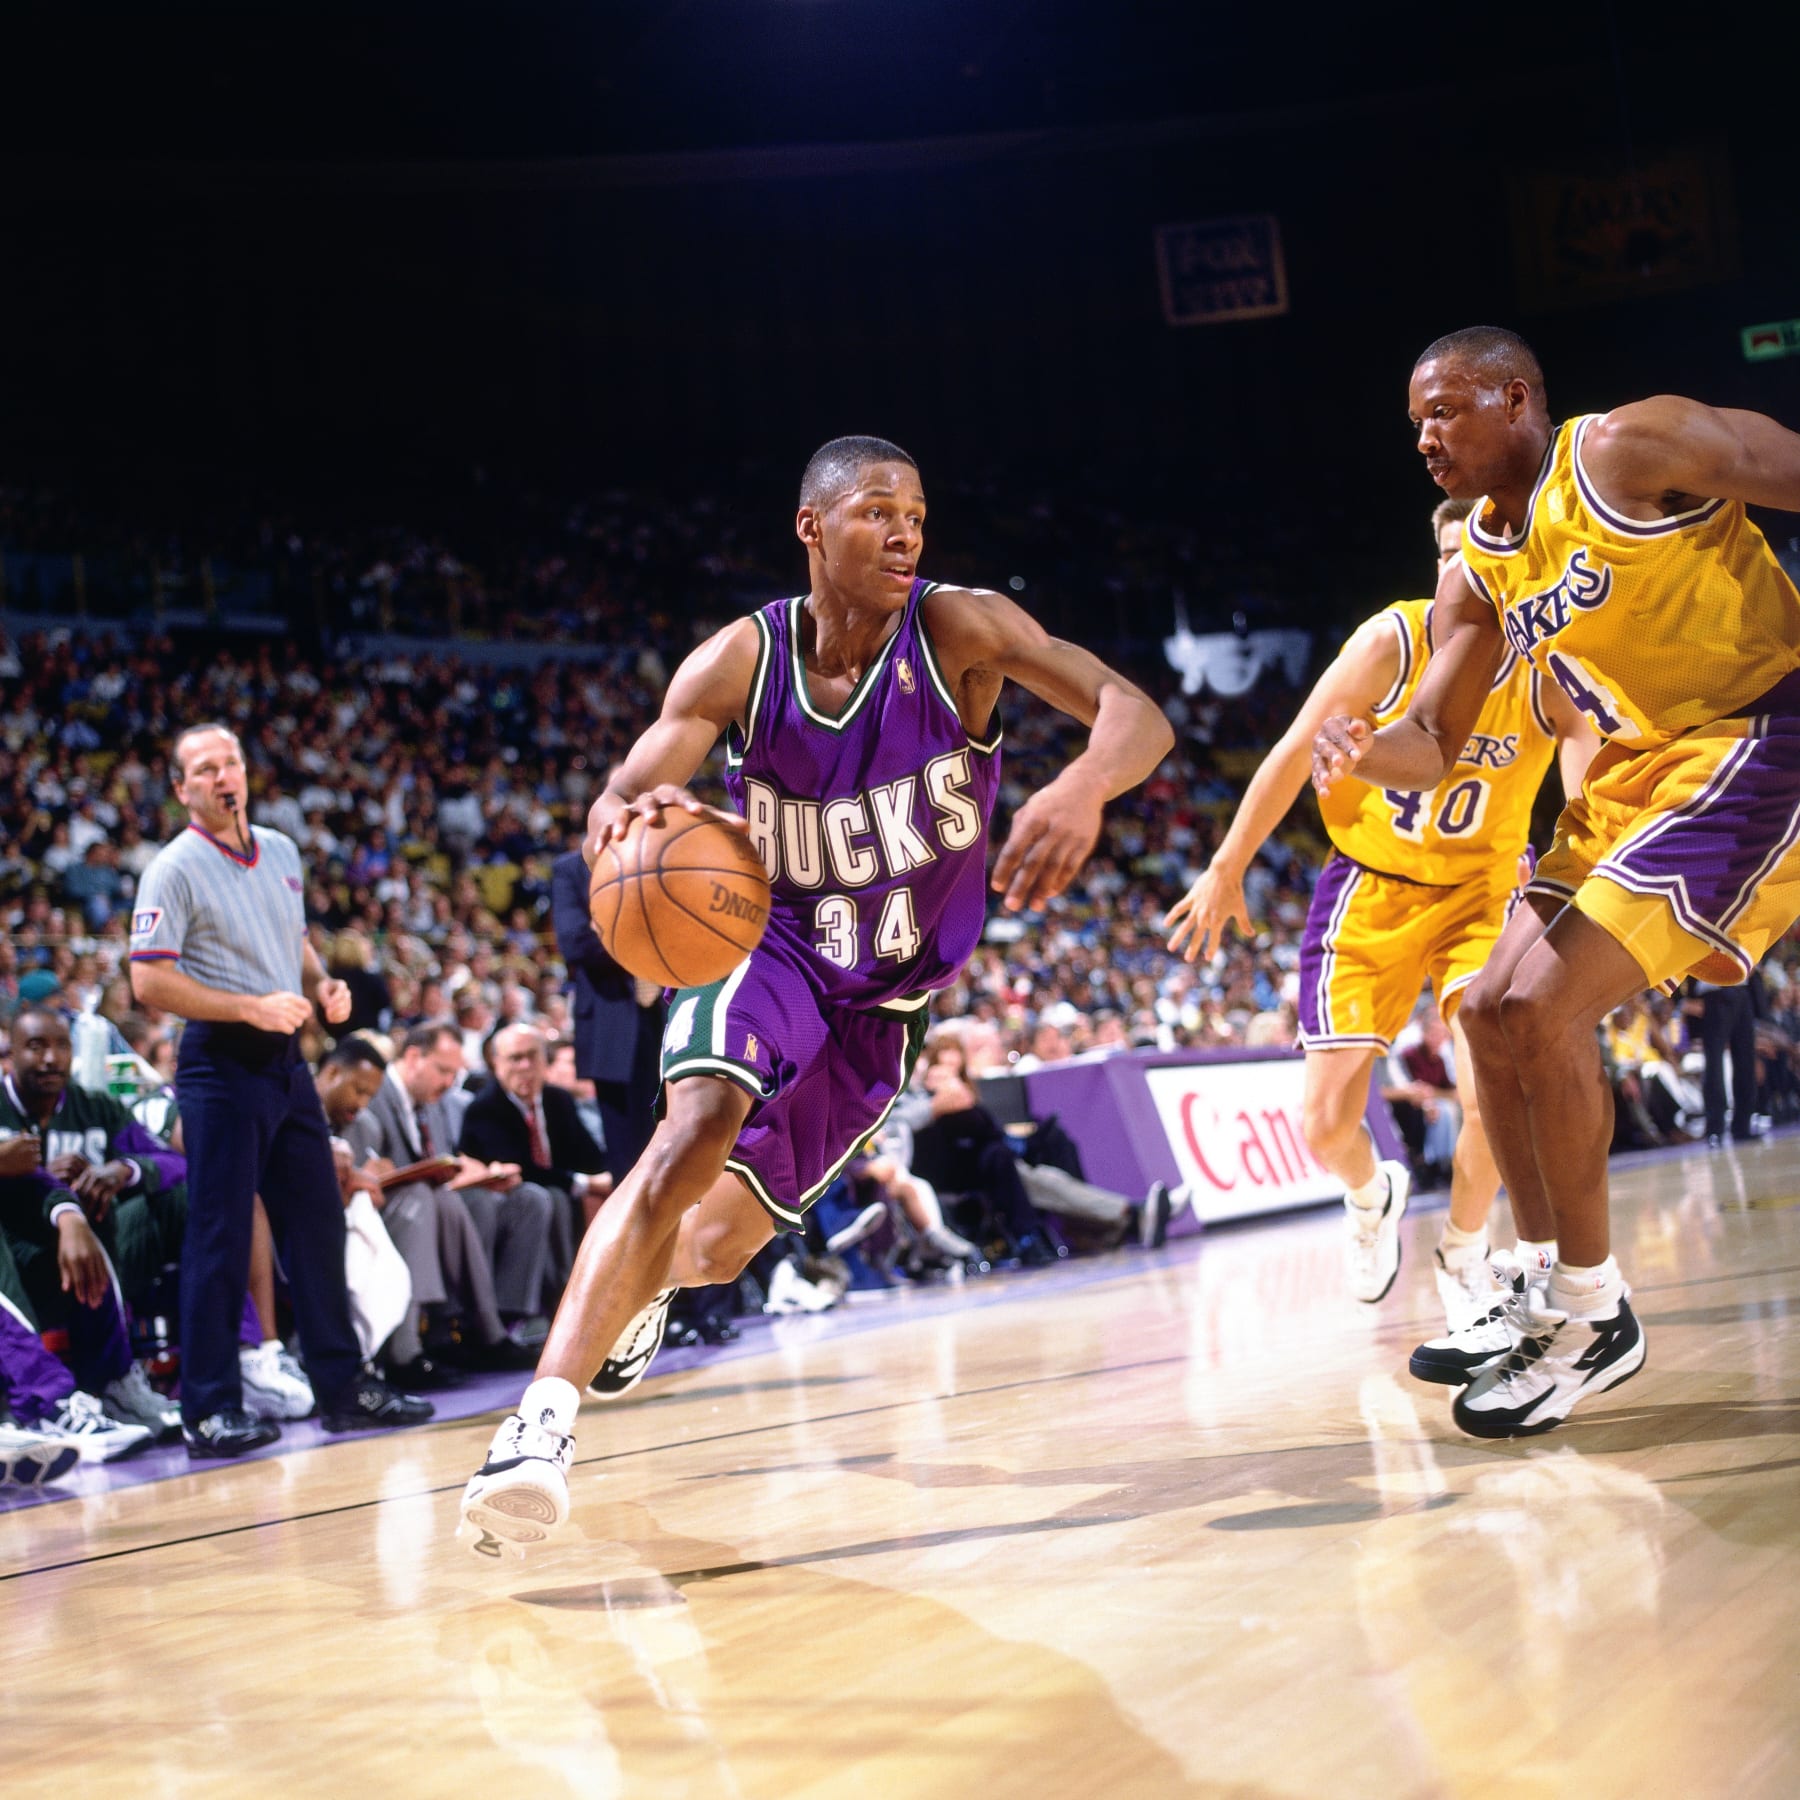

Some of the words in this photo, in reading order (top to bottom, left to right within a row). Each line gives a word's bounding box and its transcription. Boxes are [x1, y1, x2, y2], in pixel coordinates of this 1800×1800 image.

[745, 747, 981, 889] BUCKS
[1384, 779, 1491, 844] 40
[815, 887, 921, 971] 34
[1180, 1091, 1330, 1191] Can
